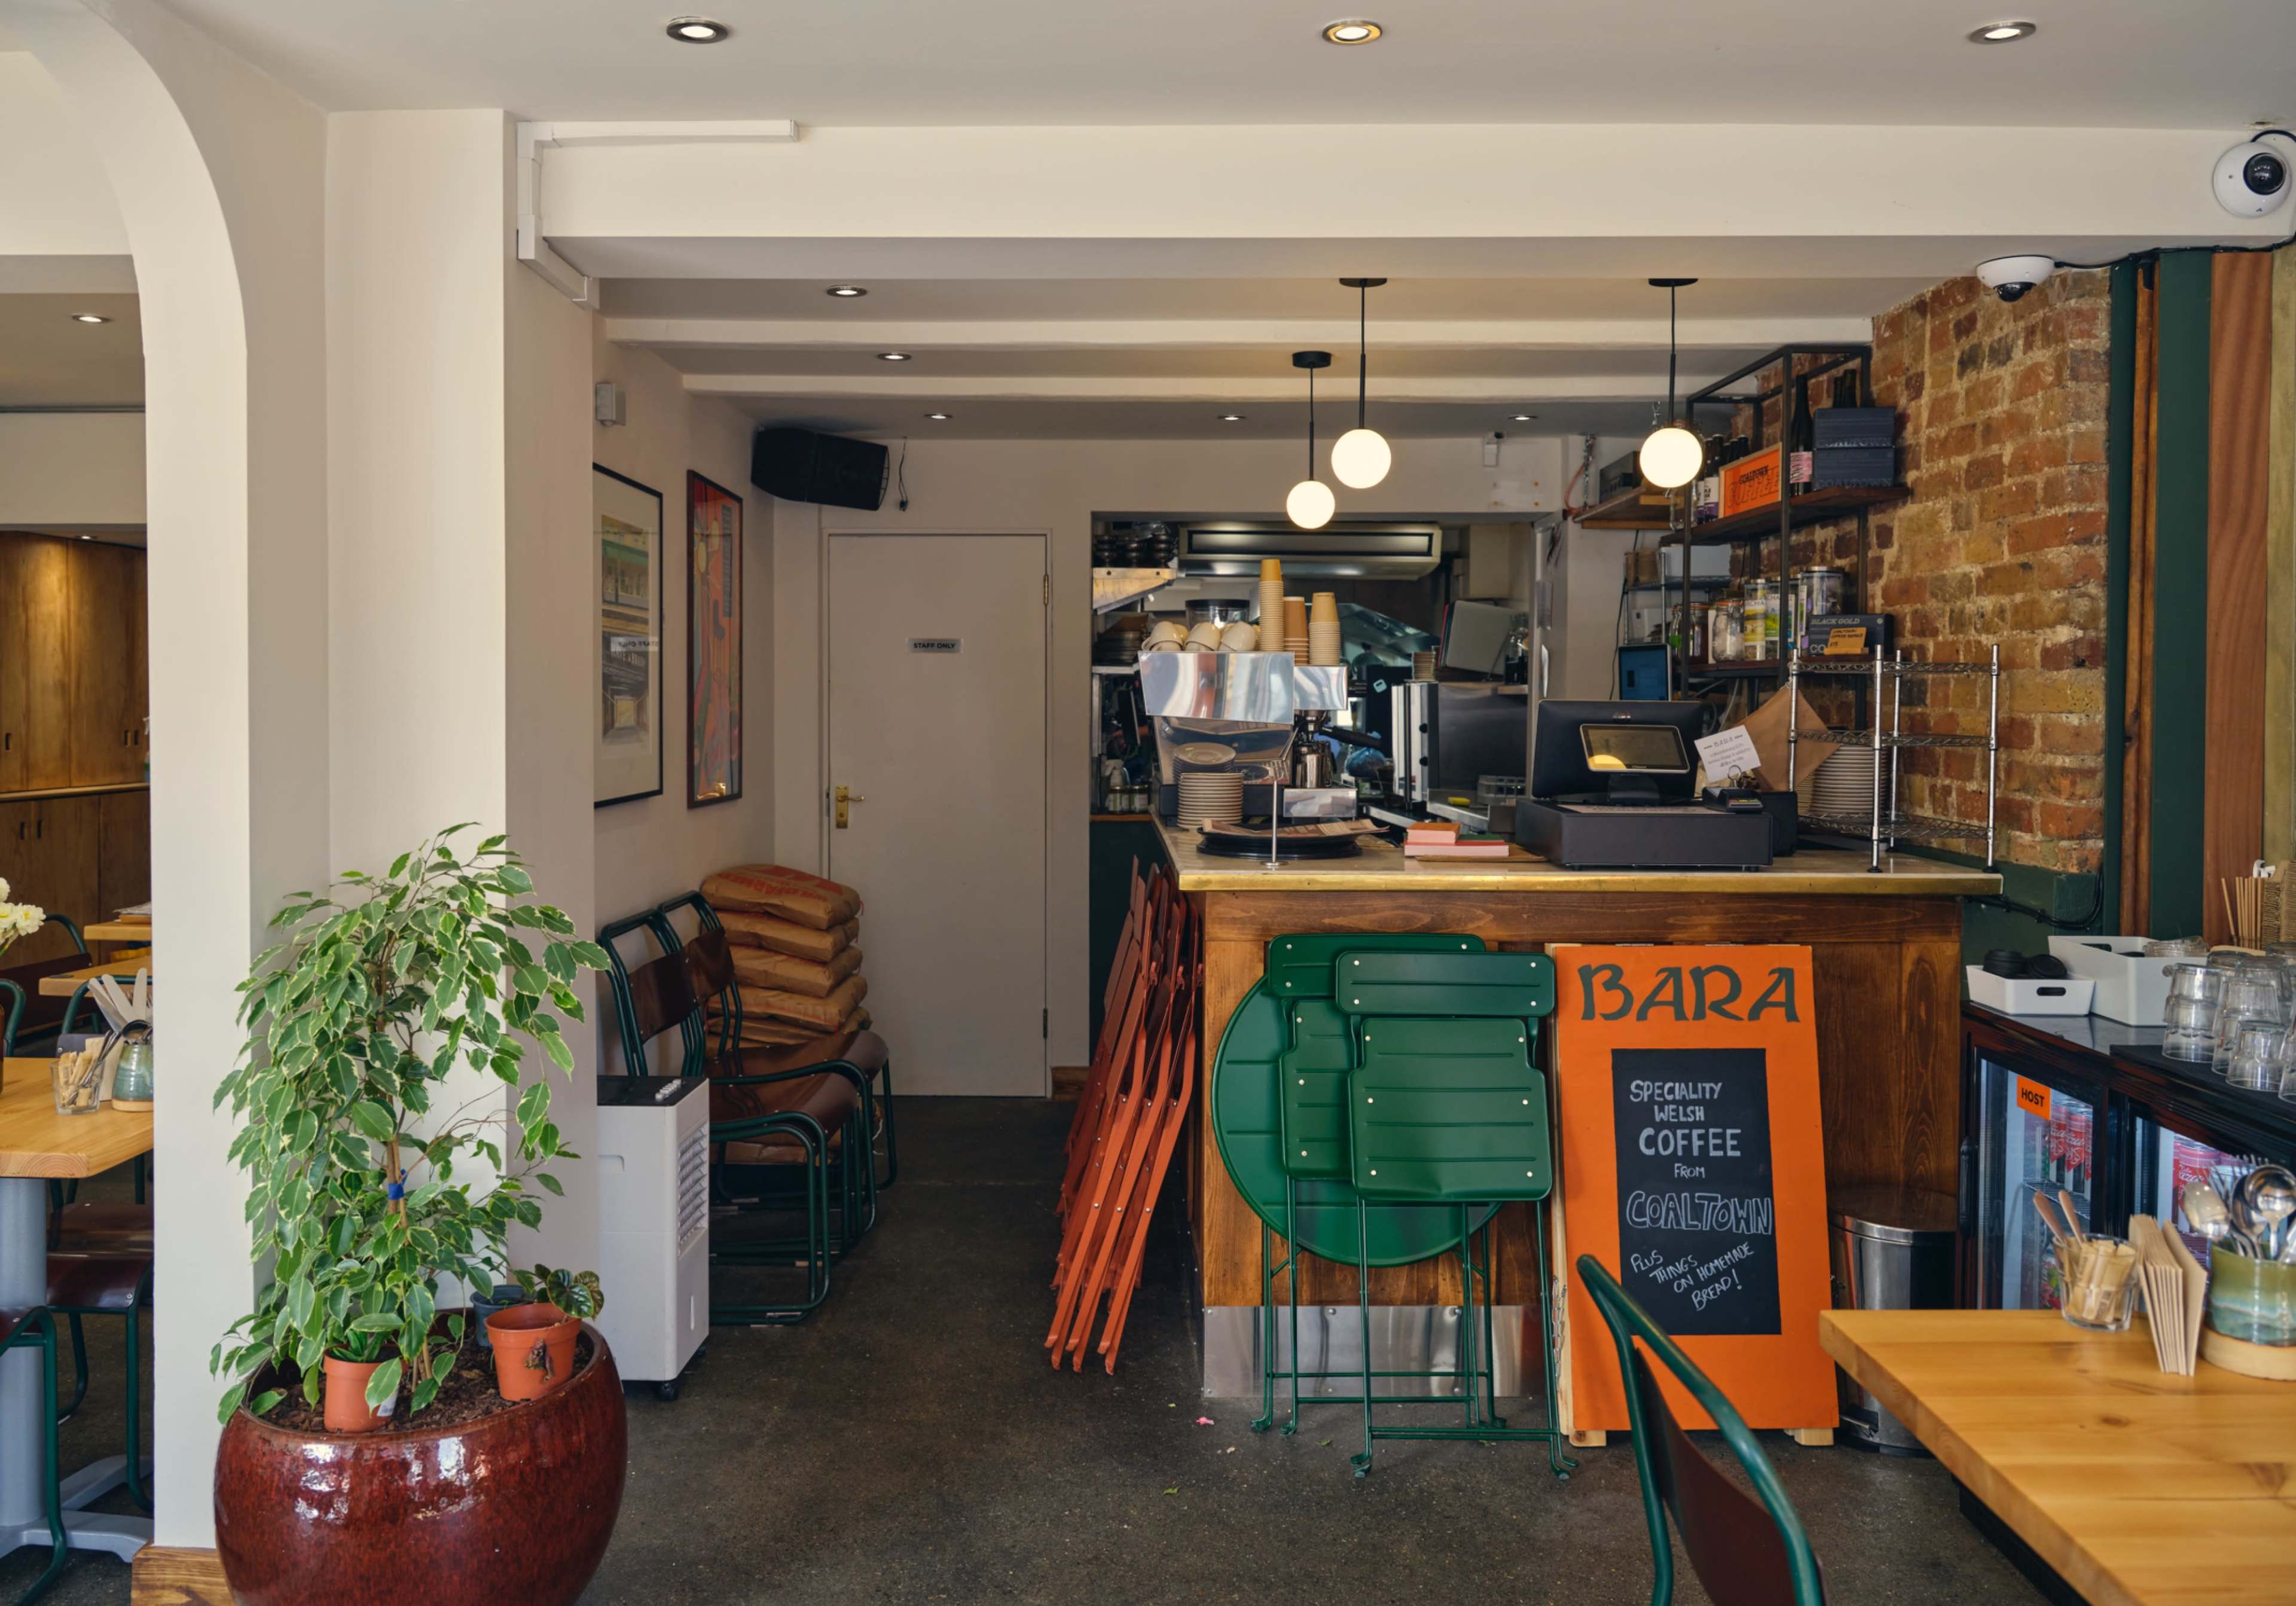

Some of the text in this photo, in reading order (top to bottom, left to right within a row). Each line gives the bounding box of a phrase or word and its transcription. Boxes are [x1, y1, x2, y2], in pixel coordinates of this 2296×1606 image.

[1577, 963, 1801, 1023] BARA
[1629, 1080, 1723, 1103] SPECIALITY
[2021, 1088, 2045, 1107] HOST
[1654, 1104, 1705, 1122] WELSH
[1639, 1127, 1742, 1157] COFFEE
[1674, 1163, 1705, 1179] FROM
[1626, 1190, 1772, 1235] COALTOWN
[1630, 1250, 1663, 1274] PLUS
[1649, 1254, 1698, 1284] THINGS
[1674, 1241, 1755, 1293] ON HOMEMADE
[1691, 1268, 1742, 1311] BREAD!
